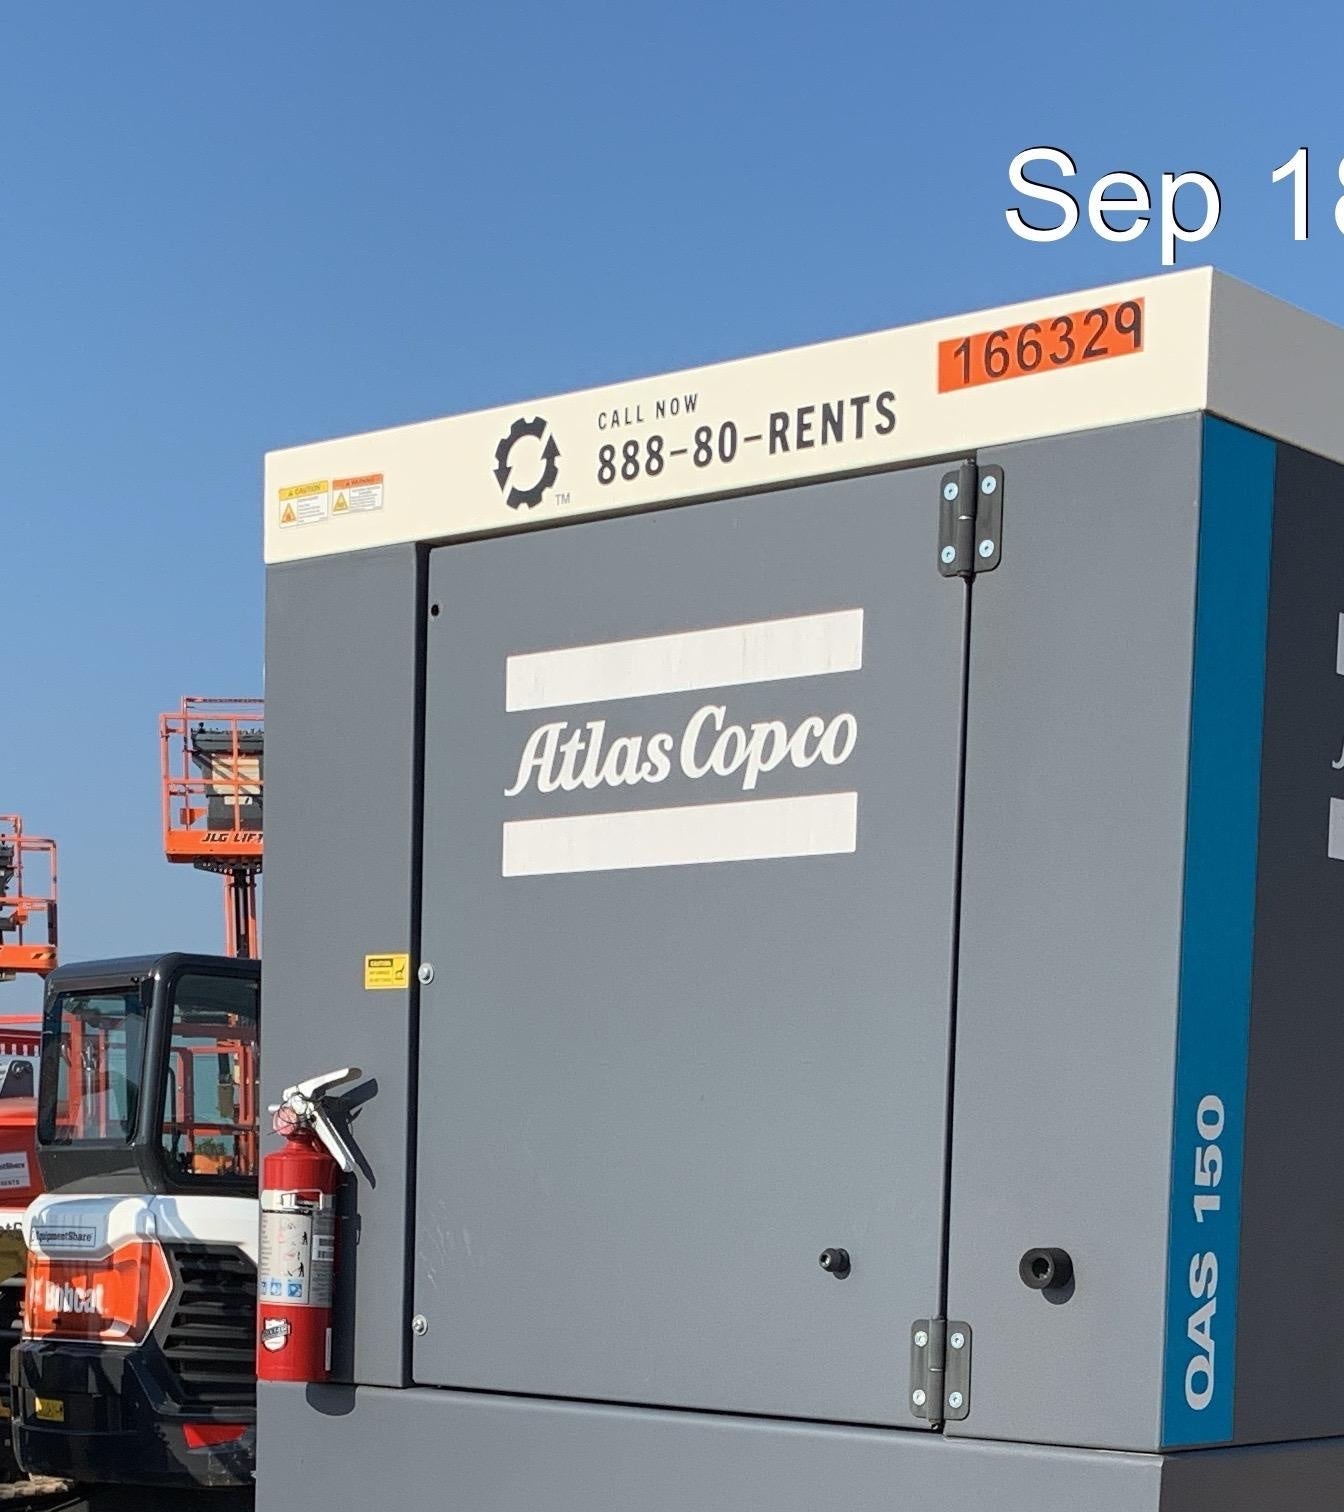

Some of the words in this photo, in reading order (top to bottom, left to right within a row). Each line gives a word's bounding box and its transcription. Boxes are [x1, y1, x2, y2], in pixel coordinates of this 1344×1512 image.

[953, 300, 1143, 384] 166329
[597, 404, 645, 430] CALL
[655, 393, 699, 420] NOW
[597, 390, 897, 486] 888-80-RENTS
[503, 719, 674, 797] Atlas
[679, 704, 858, 790] Copco
[202, 832, 230, 843] JLG
[1193, 1094, 1225, 1224] 150
[45, 1280, 105, 1314] Bobcat
[1184, 1251, 1219, 1412] QAS
